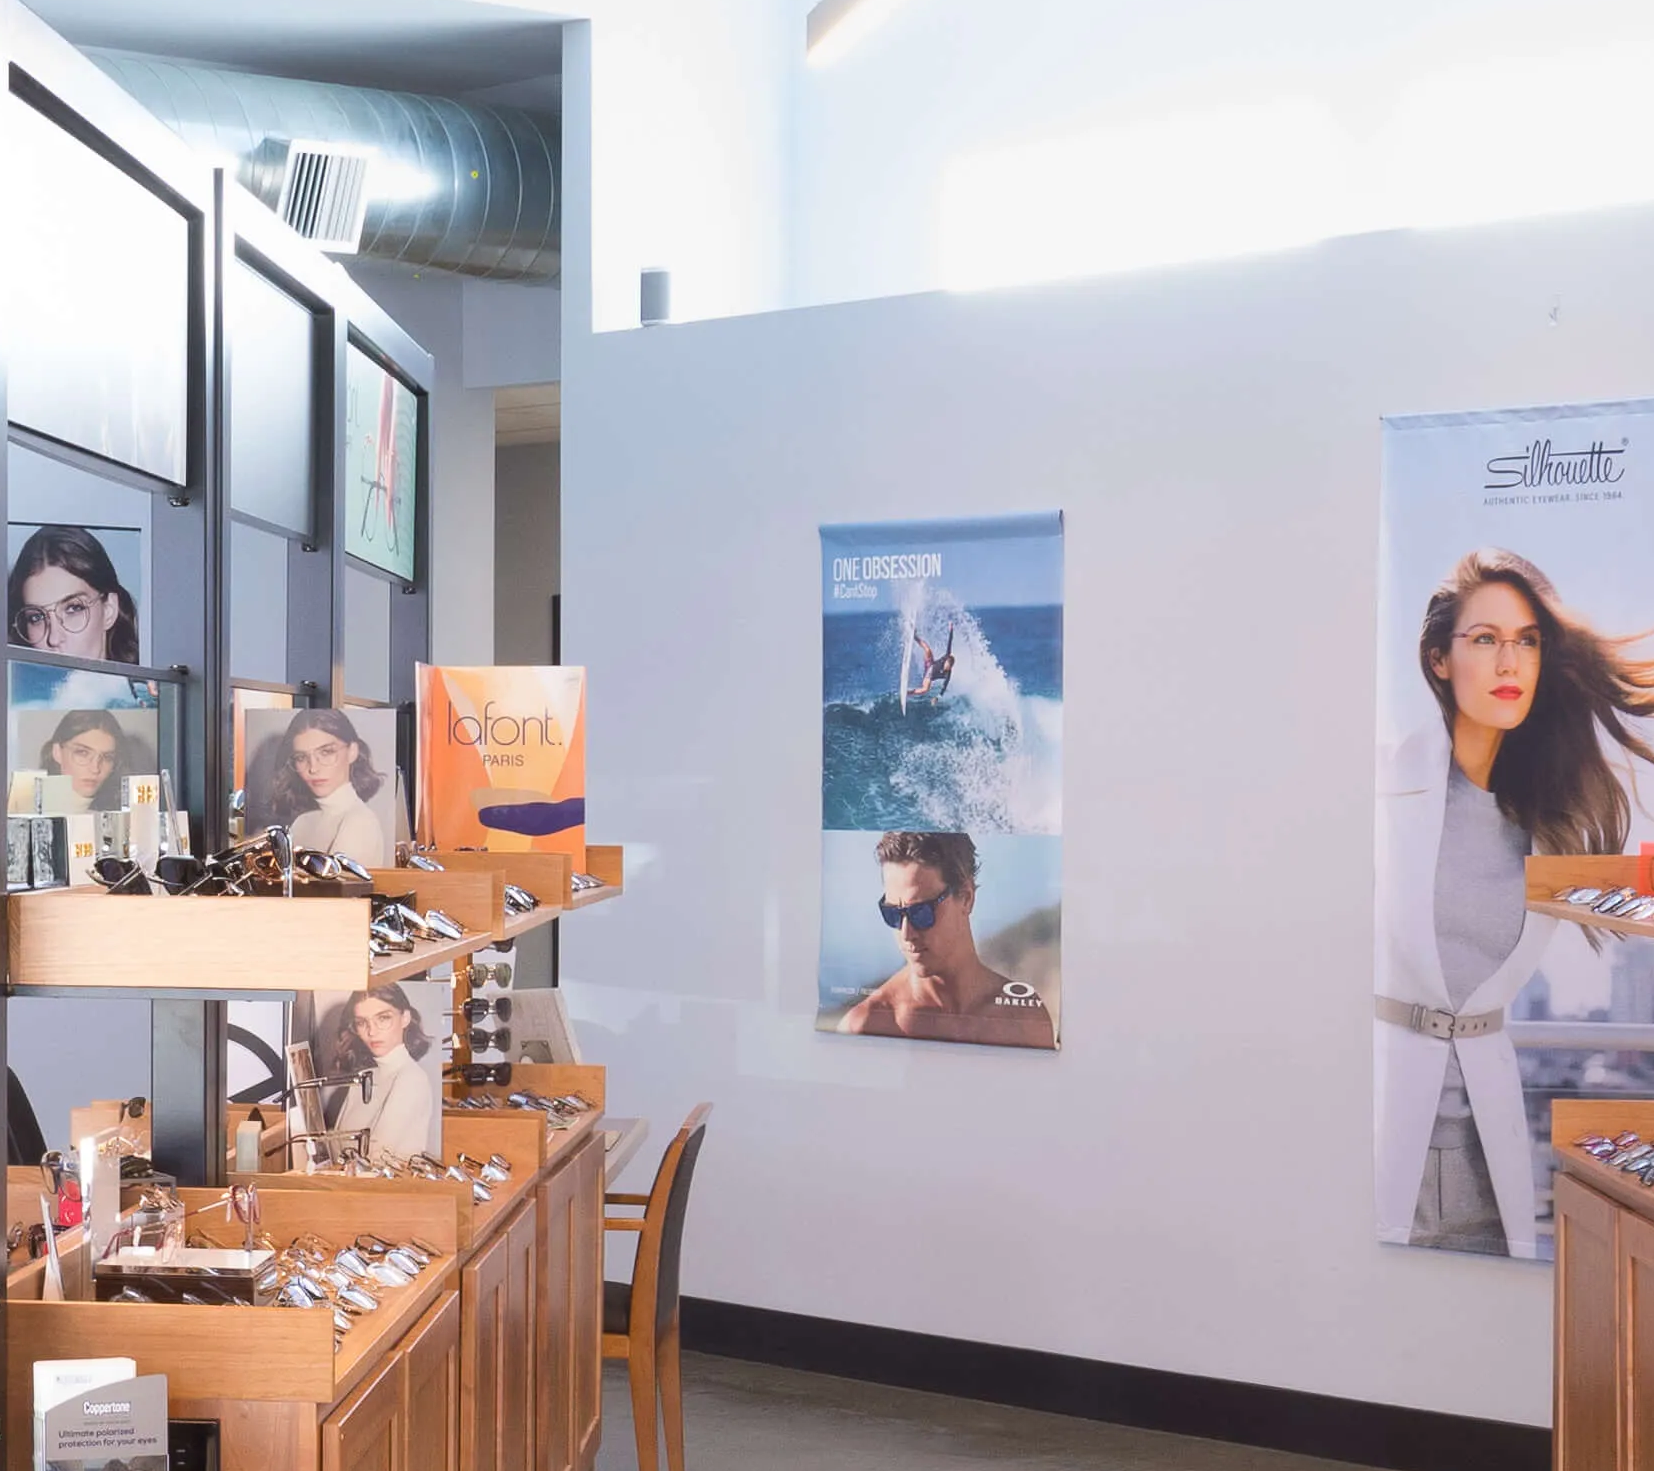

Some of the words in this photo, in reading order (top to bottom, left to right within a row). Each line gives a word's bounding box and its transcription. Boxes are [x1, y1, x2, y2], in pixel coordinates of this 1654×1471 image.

[1484, 438, 1626, 489] Silhouette
[1483, 496, 1530, 506] AUTHENTIC
[1576, 492, 1599, 502] SINCE
[833, 557, 860, 582] ONE
[862, 553, 942, 580] OBSESSION
[483, 754, 525, 767] PARIS
[995, 996, 1042, 1008] OAKLEY
[83, 1401, 131, 1415] Coppertone
[58, 1429, 94, 1439] Ultimate
[96, 1428, 135, 1438] polarized
[58, 1439, 102, 1449] protection
[103, 1438, 115, 1447] for
[116, 1438, 136, 1447] your
[137, 1436, 157, 1446] eyes
